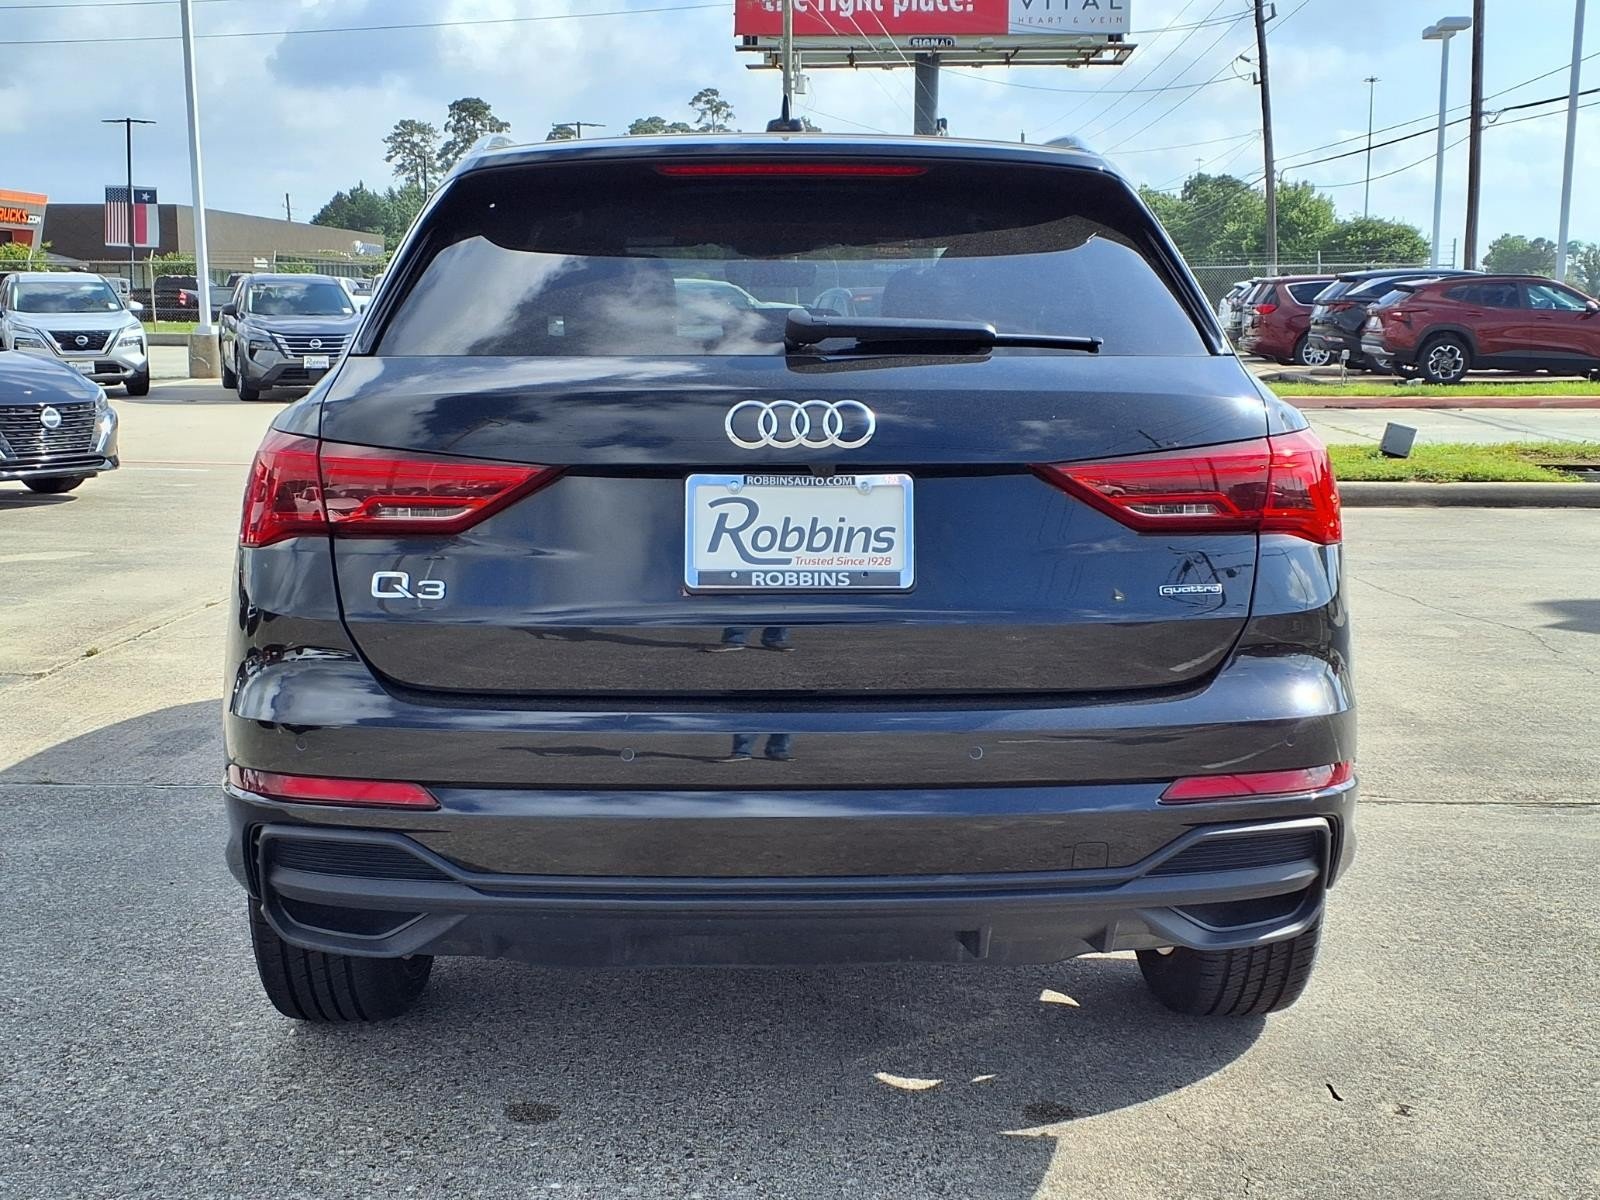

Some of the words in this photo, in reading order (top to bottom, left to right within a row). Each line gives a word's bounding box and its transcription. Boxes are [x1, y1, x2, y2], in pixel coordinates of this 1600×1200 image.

[764, 0, 808, 12] te
[1018, 16, 1062, 24] HEART
[1072, 16, 1079, 24] &
[1089, 16, 1123, 24] VEIN
[746, 475, 853, 487] ROBBINSAUTO.COM
[706, 496, 897, 566] Robbins
[795, 556, 834, 566] Trusted
[836, 556, 865, 566] Since
[867, 556, 892, 566] 1928
[751, 571, 851, 586] ROBBINS
[371, 571, 446, 600] Q3
[1162, 585, 1220, 596] quattro
